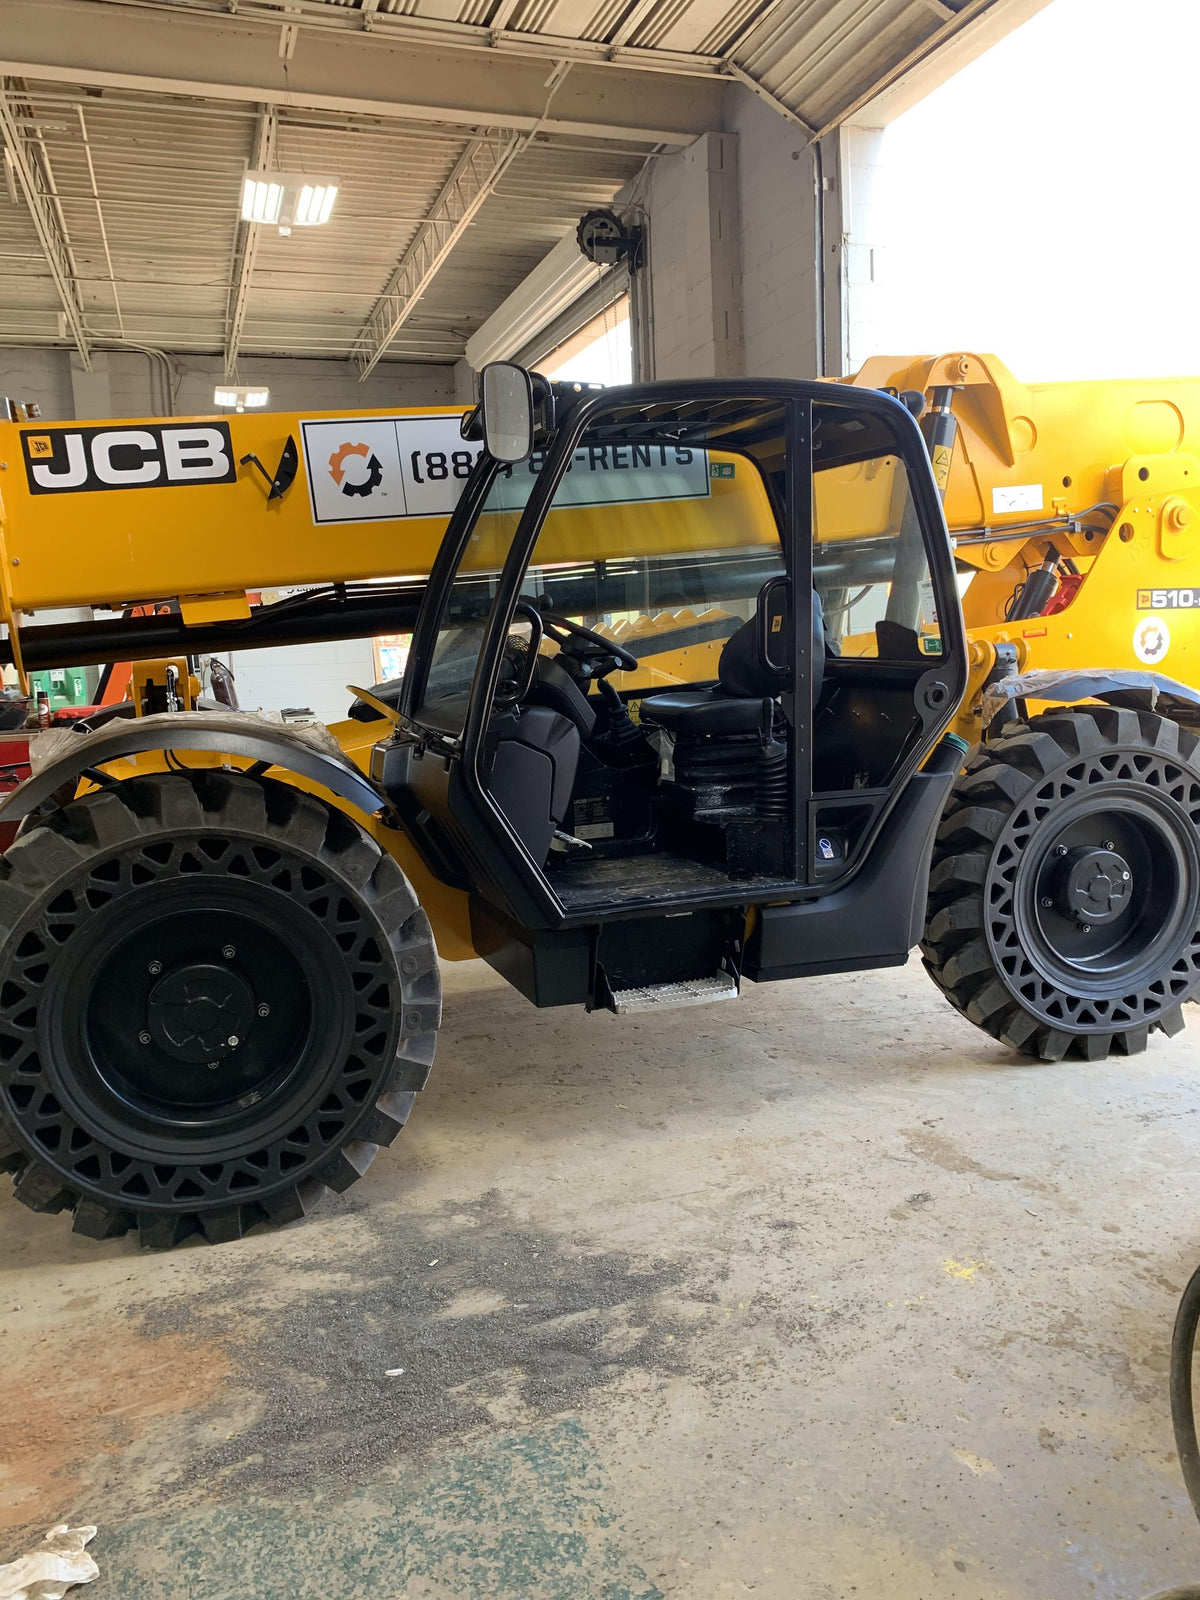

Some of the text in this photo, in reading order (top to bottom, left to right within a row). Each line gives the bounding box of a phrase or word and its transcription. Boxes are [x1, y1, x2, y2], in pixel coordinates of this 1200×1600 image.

[32, 427, 230, 488] JCB
[411, 450, 512, 484] (88
[528, 444, 693, 475] 8-RENTS
